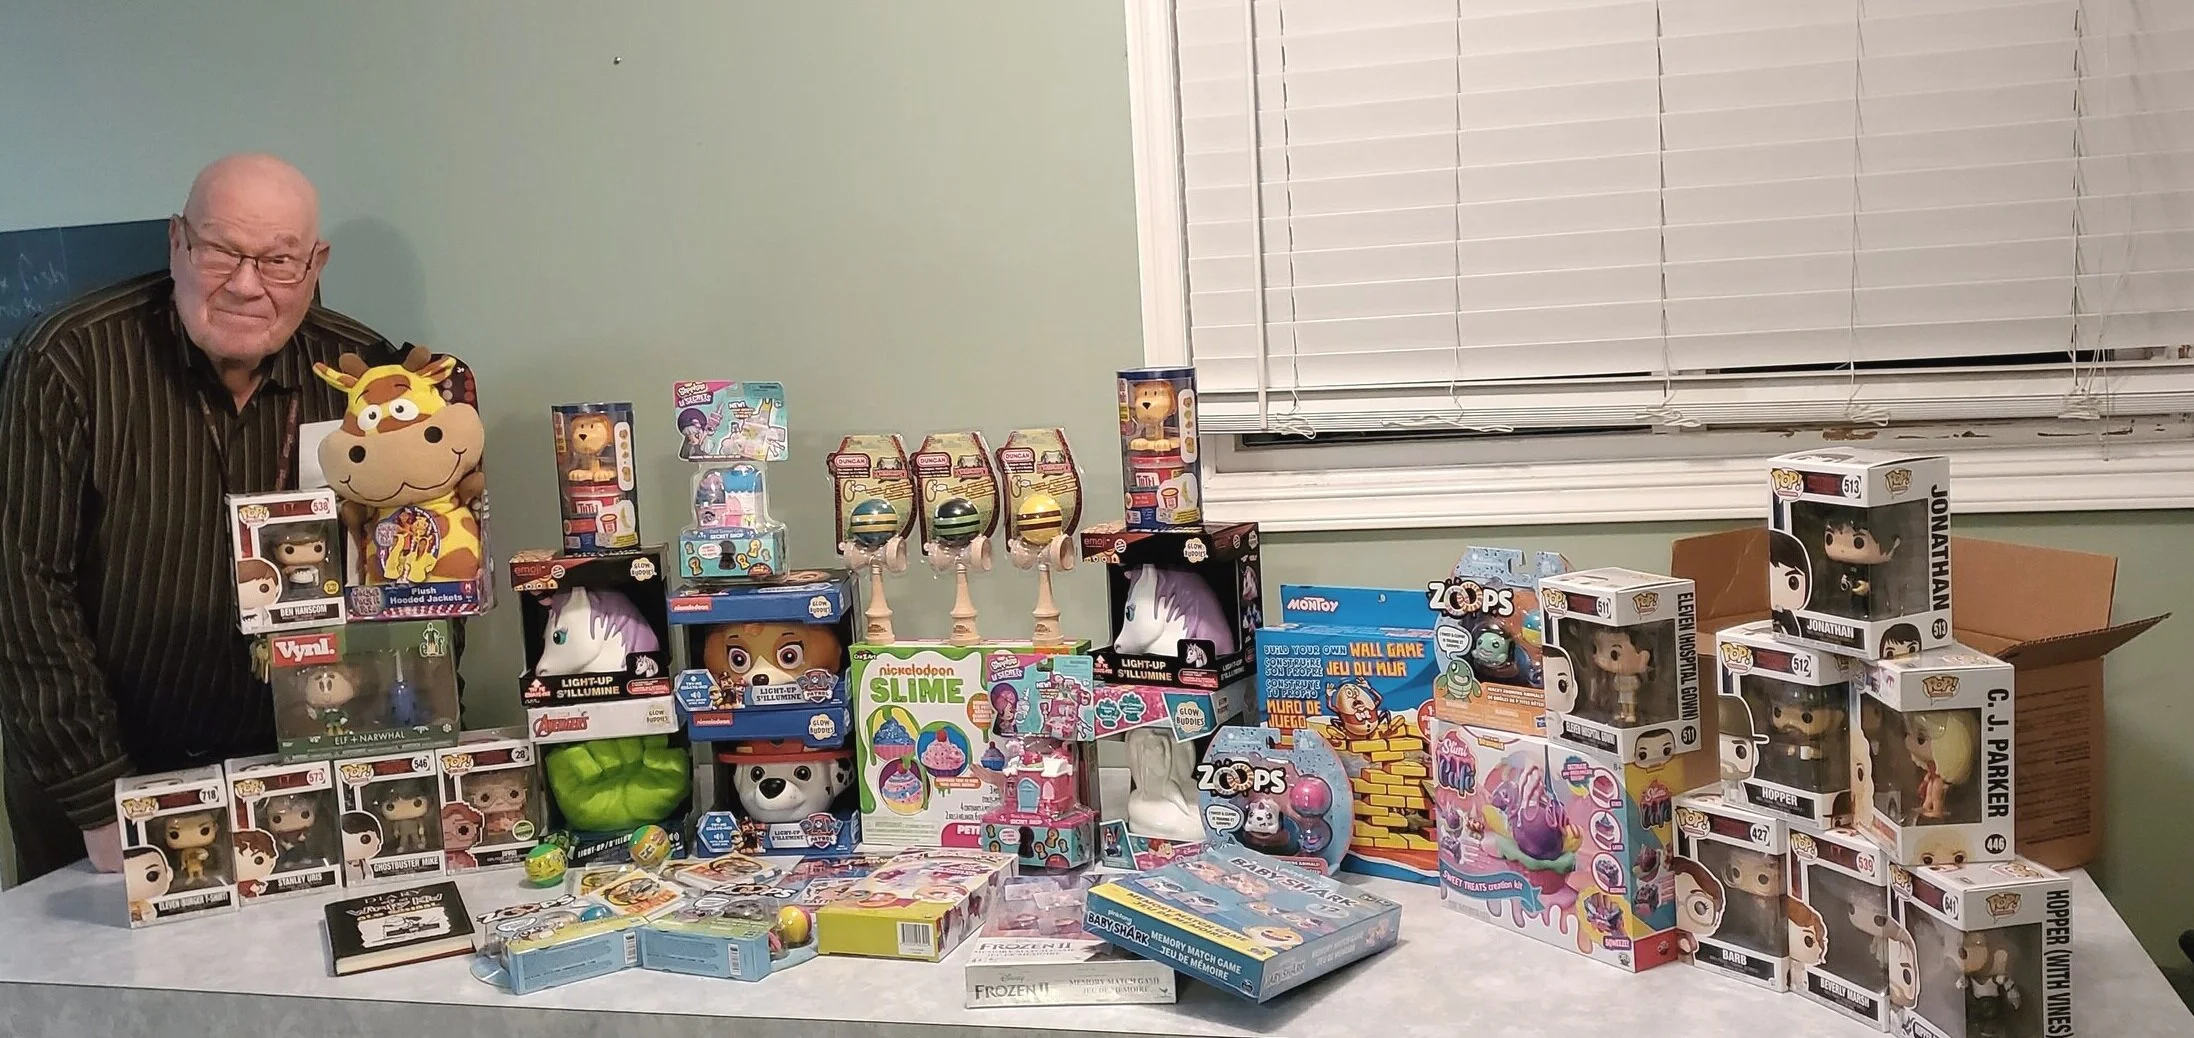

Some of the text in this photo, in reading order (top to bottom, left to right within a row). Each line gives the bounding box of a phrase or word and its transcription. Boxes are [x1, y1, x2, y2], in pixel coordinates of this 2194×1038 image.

[1771, 469, 1802, 489] POP!
[1885, 469, 1912, 487] POP!
[1844, 479, 1860, 493] 513
[283, 503, 294, 512] IT
[313, 502, 328, 511] 538
[1084, 538, 1107, 546] emoji
[1931, 485, 1950, 611] JONATHAN
[632, 569, 654, 577] BUDDIES
[634, 563, 650, 571] GLOW
[389, 594, 463, 604] Hooded Jackets
[1287, 597, 1339, 612] MONTOY
[1429, 580, 1513, 616] ZOOPS
[1542, 589, 1566, 609] POP!
[1633, 592, 1659, 607] POP!
[281, 604, 327, 616] BEN HANSCOM
[1598, 601, 1610, 614] 511
[1806, 620, 1854, 638] JONATHAN
[1933, 622, 1948, 636] 513
[275, 638, 336, 662] Vynl.
[1264, 642, 1425, 657] BUILD YOUR OWN WALL GAME
[1678, 592, 1699, 720] ELEVEN (HOSPITAL GOWN)
[1720, 642, 1752, 663] POP!
[1121, 659, 1166, 670] LIGHT-UP
[1264, 658, 1321, 667] CONSTRUIRE
[1327, 661, 1408, 677] JEU DU MUR
[1793, 659, 1809, 672] 512
[879, 664, 954, 677] nickelodeon
[1118, 669, 1172, 681] S'ILLUMINE
[1265, 667, 1323, 677] SON PROPRE
[562, 677, 613, 688] LIGHT-UP
[1266, 679, 1321, 689] CONSTRUYE
[1923, 676, 1960, 693] POP!
[557, 686, 620, 699] S'ILLUMINE
[870, 678, 966, 703] SLIME
[1267, 689, 1318, 698] TU PROPIO
[1180, 708, 1199, 716] GLOW
[1267, 700, 1322, 715] MURO DE
[1177, 718, 1205, 726] BUDDIES
[1269, 715, 1308, 728] JUEGO
[1566, 721, 1581, 734] ELEVEN
[334, 731, 405, 745] ELF + NARWHAL
[1682, 729, 1696, 742] 511
[515, 750, 526, 760] 28
[1442, 739, 1468, 757] Slimi
[1987, 689, 2009, 818] C. J. PARKER
[414, 759, 427, 769] 546
[441, 754, 473, 769] POP!
[309, 772, 324, 782] 573
[340, 764, 373, 779] POP!
[1197, 760, 1287, 797] ZOOPS
[235, 780, 265, 794] POP!
[202, 790, 216, 801] 718
[1762, 787, 1798, 806] HOPPER
[1676, 808, 1709, 831] POP!
[1752, 829, 1768, 842] 427
[1791, 833, 1817, 854] POP!
[1831, 844, 1842, 855] IT
[1987, 838, 2004, 850] 446
[374, 857, 438, 872] GHOSTBUSTER MIKE
[1858, 857, 1874, 871] 539
[278, 873, 322, 887] STANLEY URIS
[1231, 857, 1357, 908] BABY SHARK
[1443, 870, 1523, 892] SWEET TREATS creation kit
[1889, 864, 1913, 887] POP!
[477, 894, 577, 924] ZOOPS
[1133, 901, 1156, 912] JEU
[1986, 893, 2022, 911] POP!
[1108, 909, 1132, 926] pinkfong
[1127, 892, 1249, 942] MEMORY MATCH GAME
[1087, 912, 1150, 947] BABY SHARK
[979, 942, 1055, 951] FROZEN
[1151, 931, 1187, 952] MEMORY
[1187, 944, 1217, 962] MATCH
[1217, 957, 1242, 974] GAME
[1160, 945, 1229, 981] JEU DE MÉMOIRE
[1723, 949, 1747, 966] BARB
[2044, 890, 2074, 1038] HOPPER (WITH VINES)
[1070, 978, 1105, 986] MEMORY
[975, 982, 1049, 1000] FROZEN II
[1820, 977, 1870, 1008] BEVERLY MARSH
